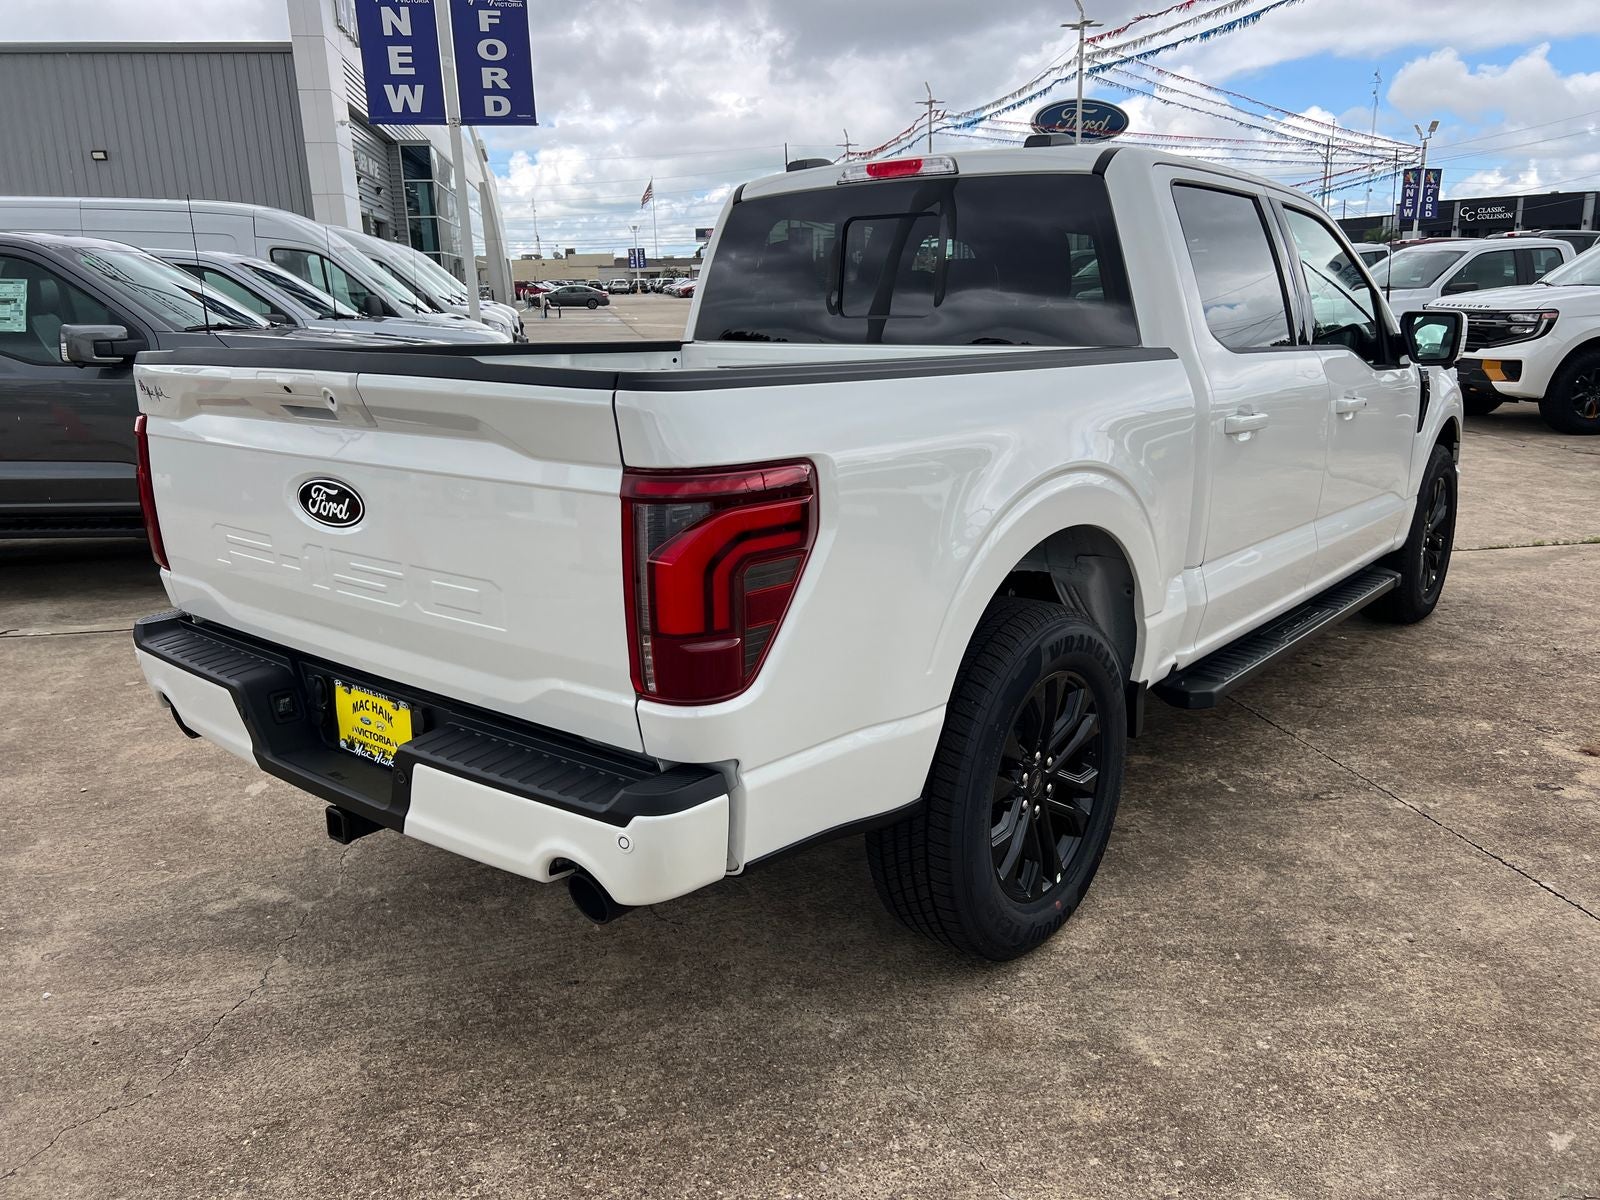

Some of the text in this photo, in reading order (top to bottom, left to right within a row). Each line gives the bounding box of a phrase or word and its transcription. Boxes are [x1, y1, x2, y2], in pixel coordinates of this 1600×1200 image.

[380, 6, 424, 113] NEW
[477, 10, 512, 117] FORD
[1056, 107, 1112, 132] Frd
[1403, 188, 1415, 217] NEW
[1425, 188, 1434, 218] FORD
[1476, 212, 1514, 220] COLLISION
[1477, 206, 1506, 214] CLASSIC
[308, 484, 349, 520] Ford
[352, 699, 394, 728] MAC HAIK
[358, 727, 392, 747] VICTORIA
[354, 743, 394, 768] Mac Haik
